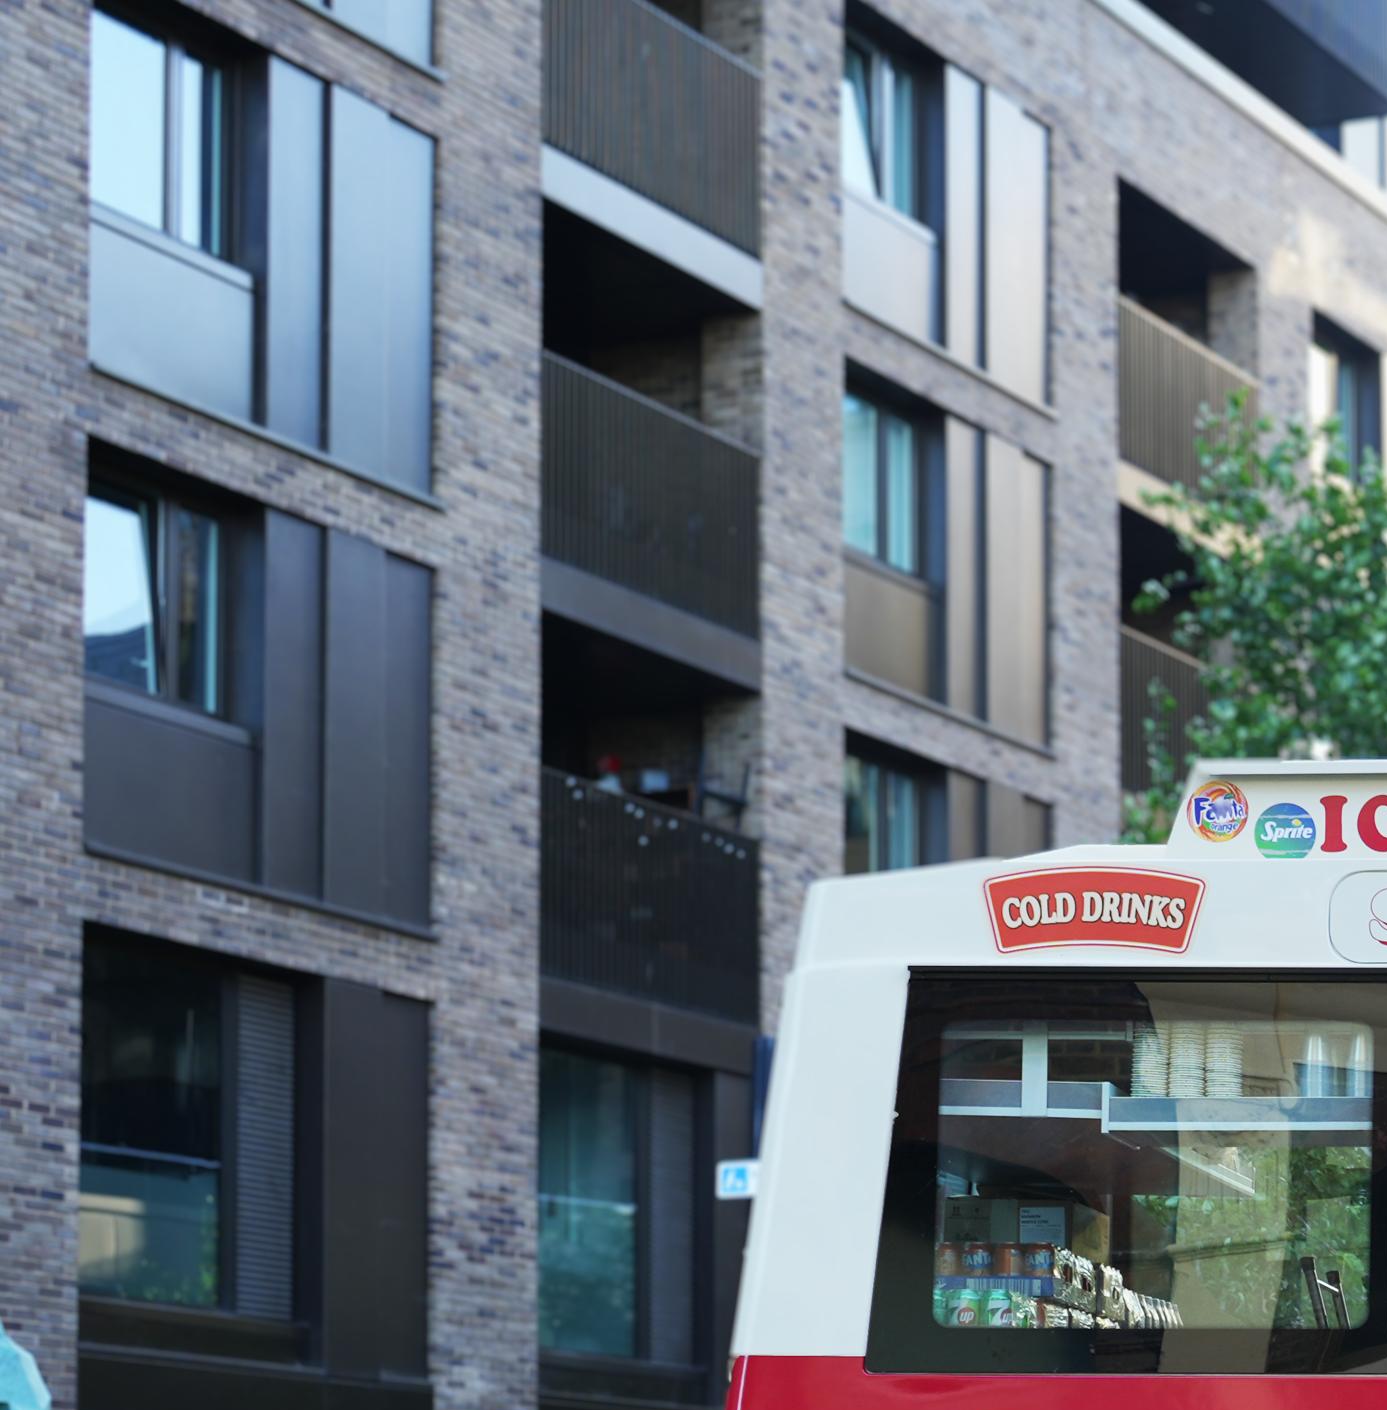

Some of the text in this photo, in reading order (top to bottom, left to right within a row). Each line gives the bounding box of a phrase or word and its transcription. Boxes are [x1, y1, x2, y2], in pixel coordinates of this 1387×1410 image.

[1260, 821, 1314, 843] Sprite
[1000, 889, 1187, 930] COLD DRINKS
